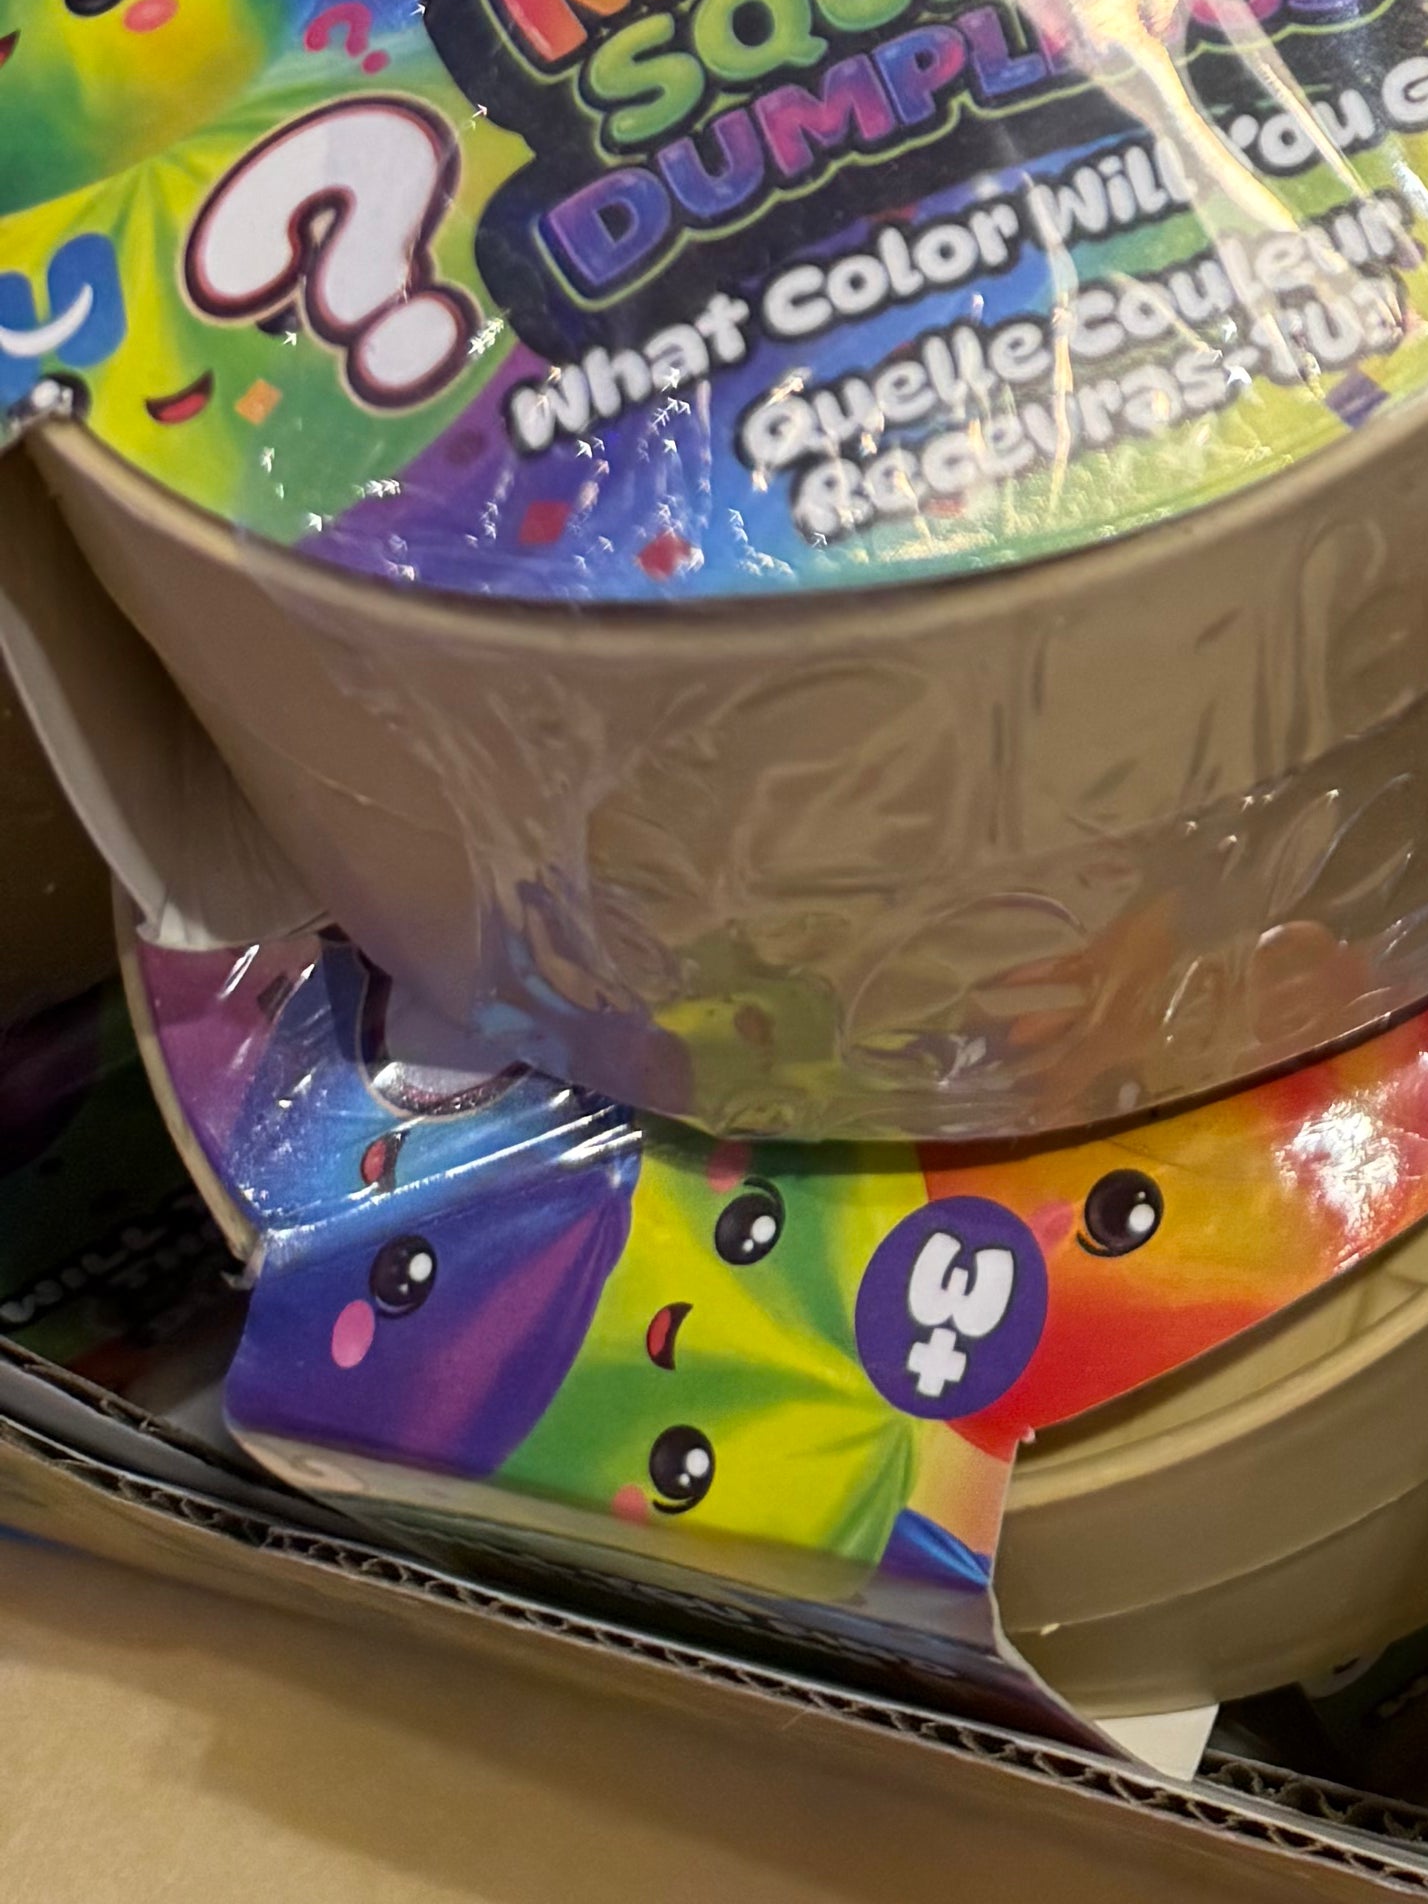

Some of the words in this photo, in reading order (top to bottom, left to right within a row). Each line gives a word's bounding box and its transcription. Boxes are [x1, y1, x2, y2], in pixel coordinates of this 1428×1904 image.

[509, 295, 746, 445] What
[762, 206, 1018, 337] Color
[1026, 136, 1196, 233] Will
[743, 314, 1050, 464] Quelle
[1070, 197, 1403, 357] Couleur
[909, 1233, 1013, 1397] 3+
